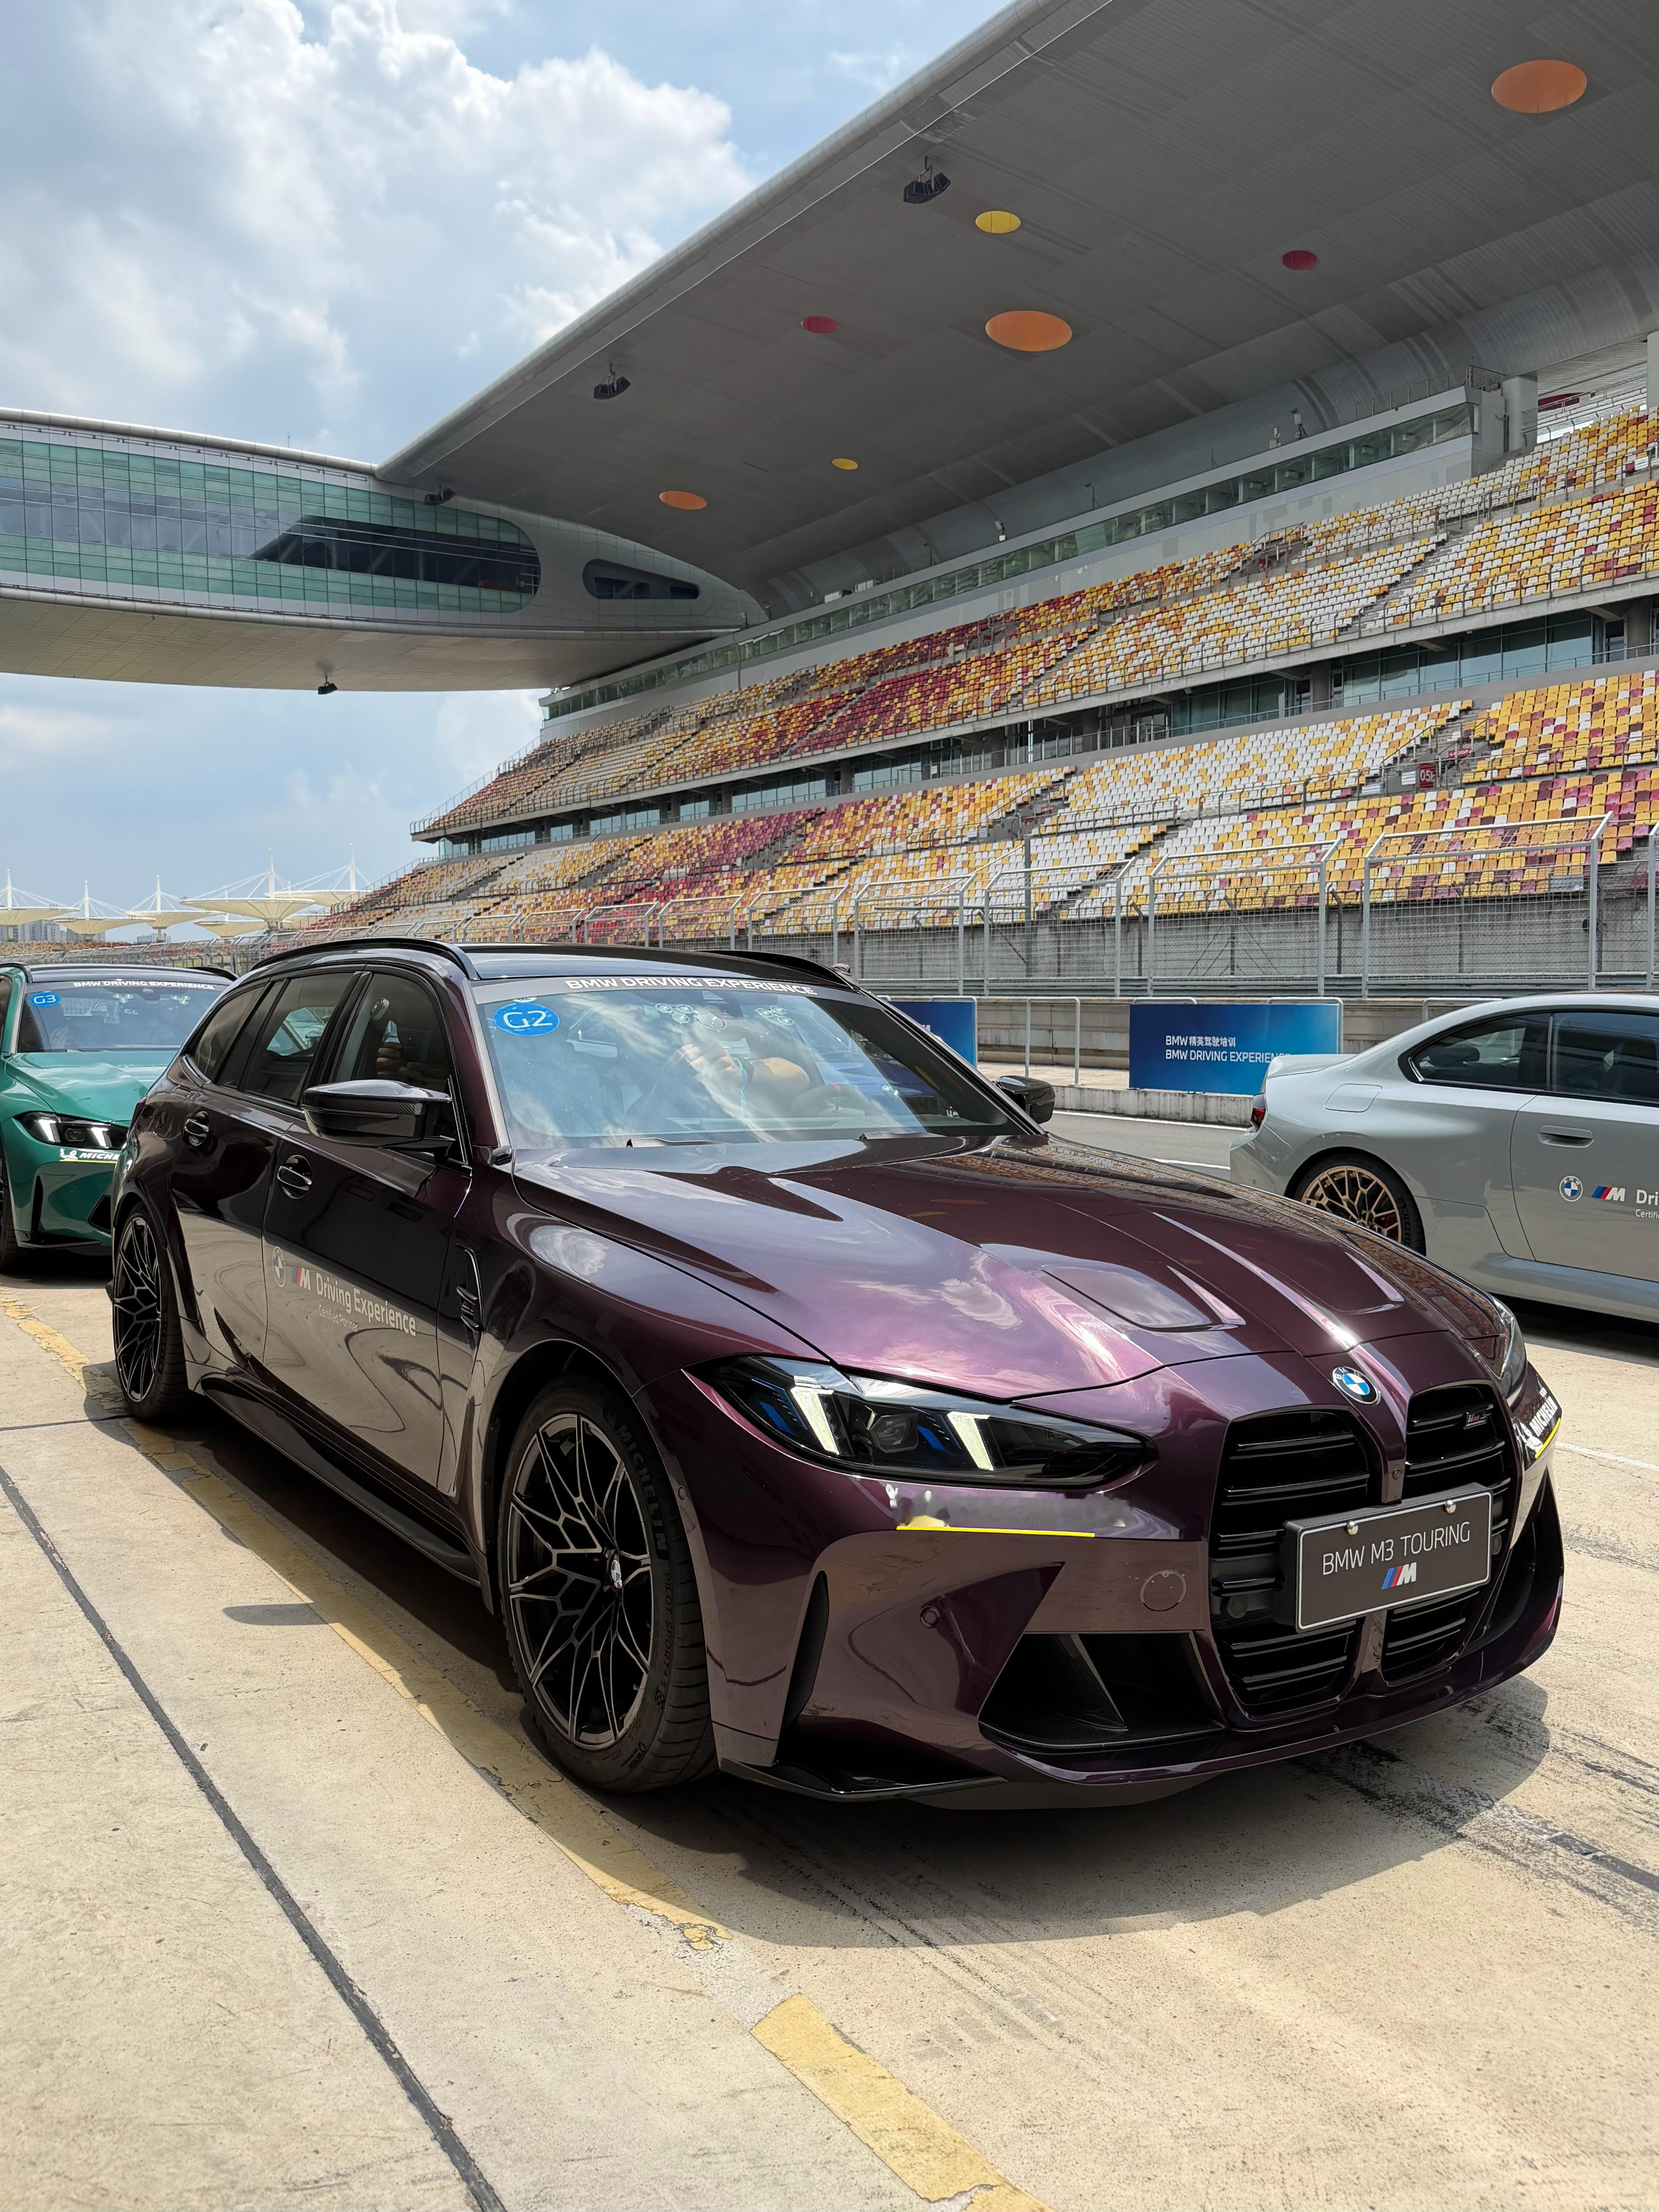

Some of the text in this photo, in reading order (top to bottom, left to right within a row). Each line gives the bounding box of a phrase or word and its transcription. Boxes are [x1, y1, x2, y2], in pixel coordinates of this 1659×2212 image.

[33, 995, 56, 1004] G3
[149, 981, 215, 990] EXPERIENCE
[566, 977, 817, 996] BMW DRIVING EXPERIENCE
[503, 1010, 553, 1028] G2
[1165, 1049, 1290, 1063] BMW DRIVING EXPERIE
[1636, 1189, 1659, 1206] Dri
[316, 1272, 352, 1314] Driving
[353, 1288, 417, 1336] Experience
[1529, 1396, 1558, 1437] MICHELIN
[617, 1423, 667, 1551] MICHELIN
[1323, 1521, 1470, 1576] BMW M3 TOURING
[664, 1573, 673, 1614] PILOT
[664, 1621, 672, 1667] SPORT
